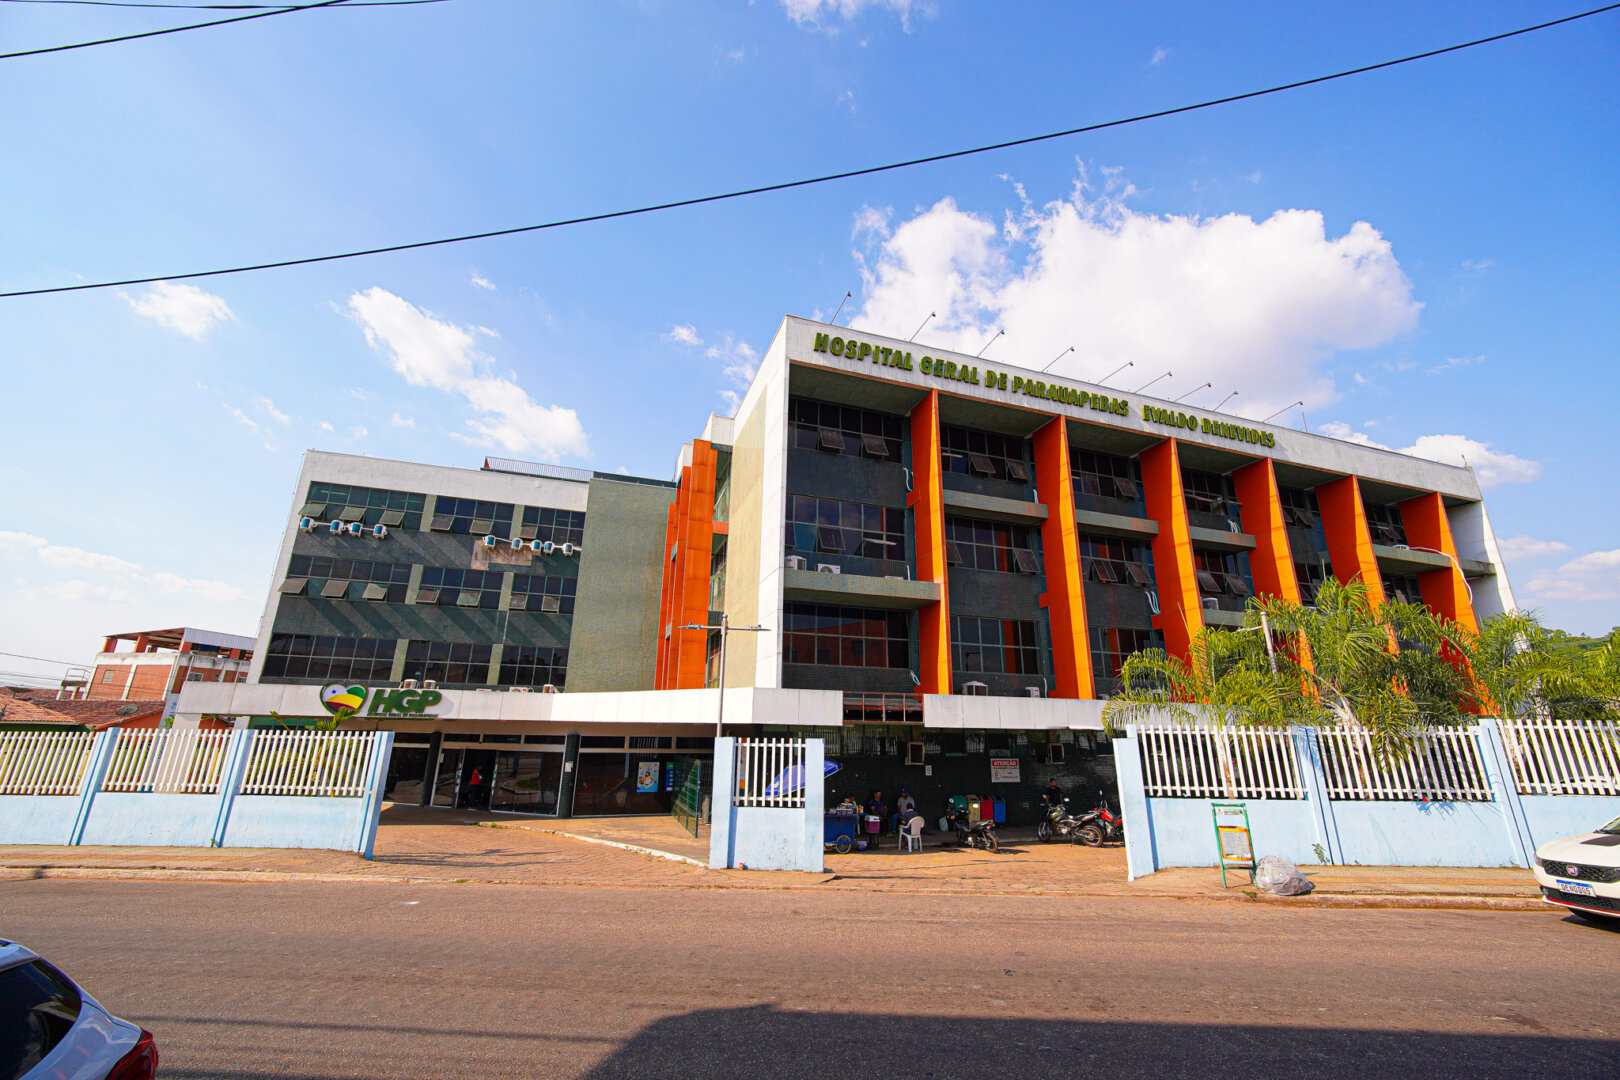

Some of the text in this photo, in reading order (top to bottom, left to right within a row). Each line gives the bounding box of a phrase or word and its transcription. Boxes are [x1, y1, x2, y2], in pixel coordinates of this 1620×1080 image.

[814, 332, 1129, 417] HOSPITAL GERAL DE PARAUAPEBAS
[1142, 404, 1276, 448] EVALDO BENEVIDES
[368, 689, 442, 713] HGP
